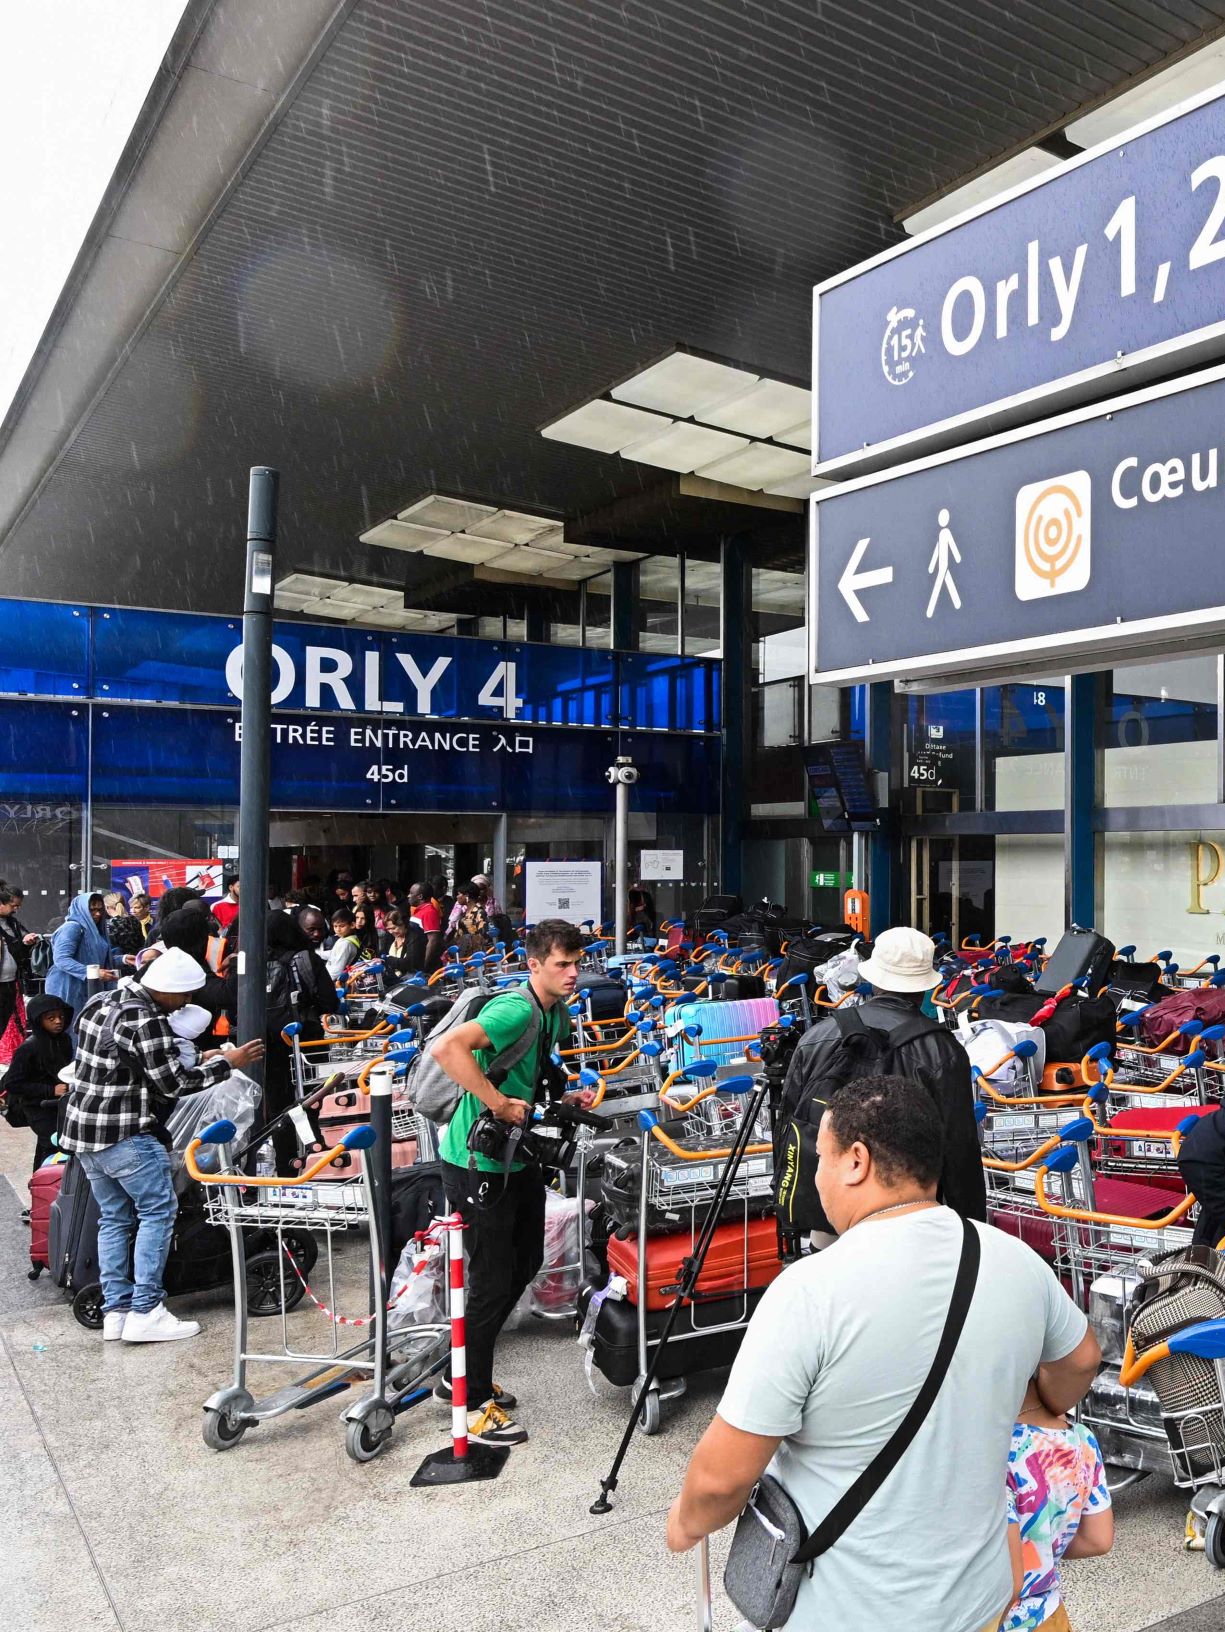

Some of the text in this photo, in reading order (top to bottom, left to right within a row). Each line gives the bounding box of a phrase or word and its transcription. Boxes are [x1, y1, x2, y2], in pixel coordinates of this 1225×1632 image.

[941, 239, 1088, 356] Orly
[890, 328, 912, 361] 15
[895, 361, 910, 375] min
[225, 643, 524, 719] ORLY 4
[234, 722, 534, 755] ETRÉE ENTRANCE 入口
[365, 764, 409, 784] 45d
[910, 765, 936, 780] 45d
[781, 1143, 796, 1188] XINYANG
